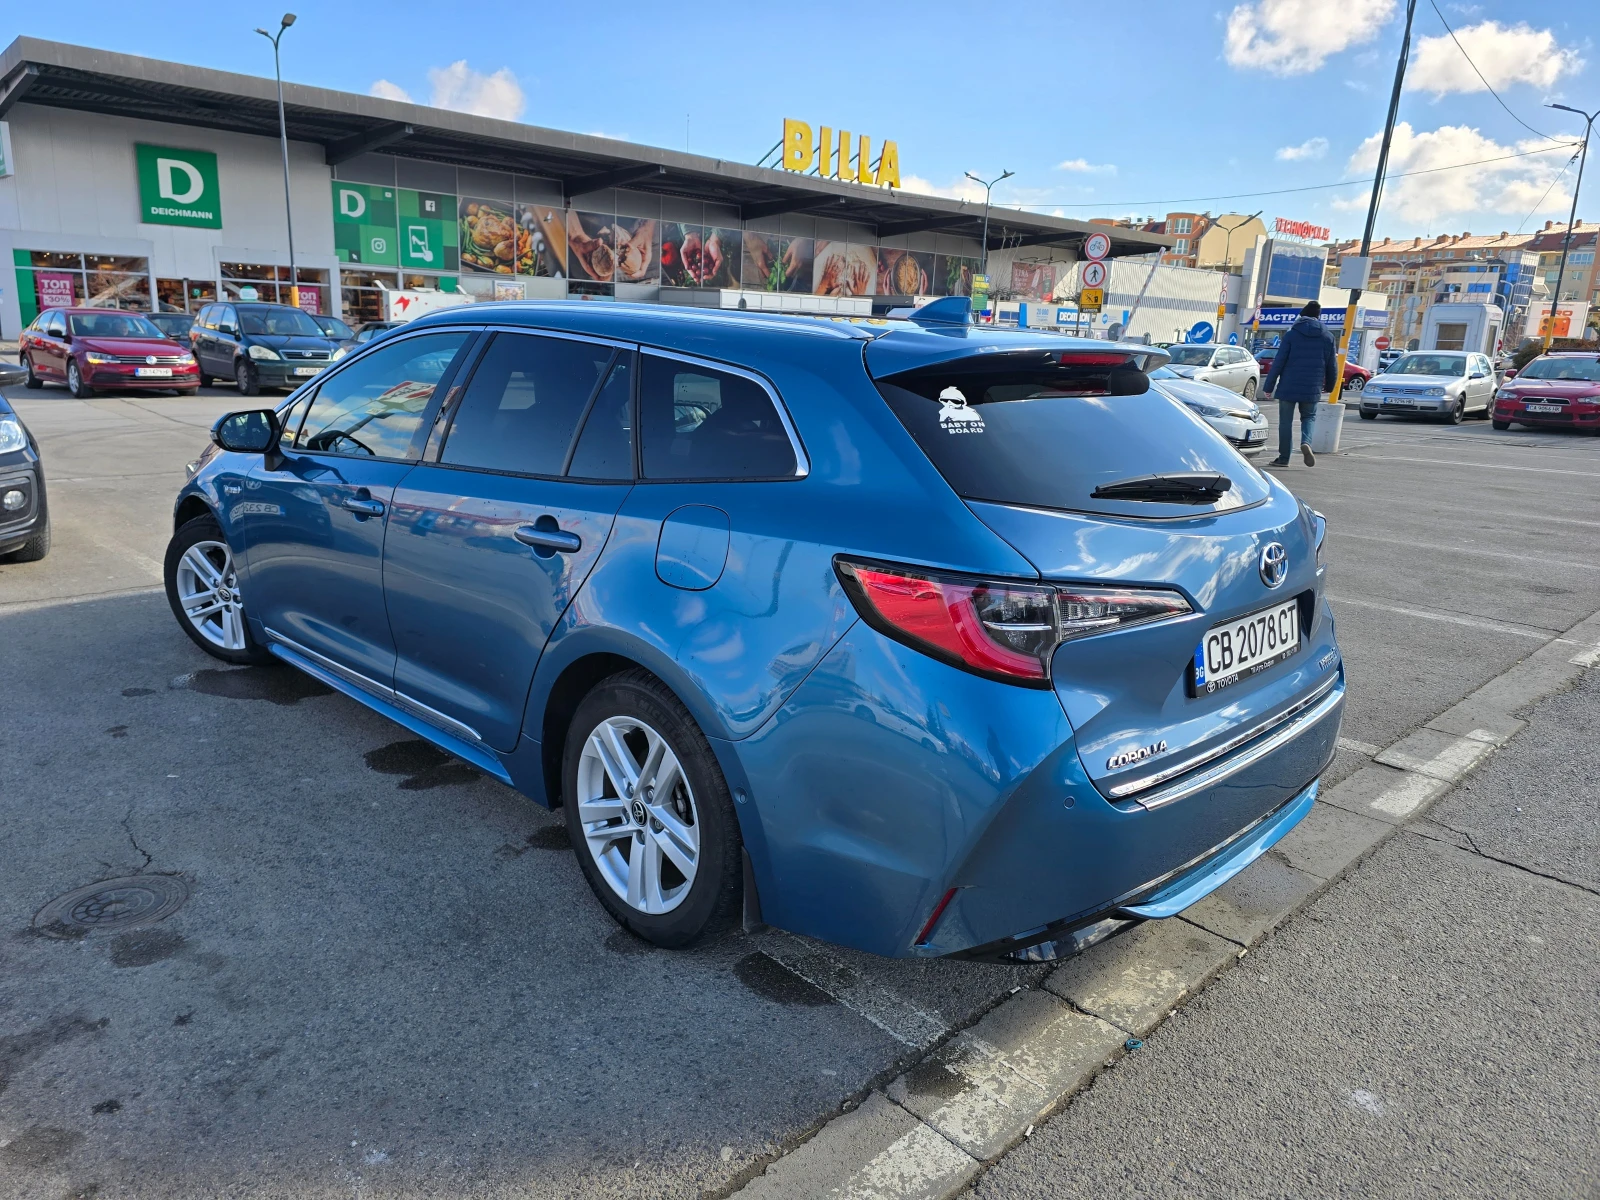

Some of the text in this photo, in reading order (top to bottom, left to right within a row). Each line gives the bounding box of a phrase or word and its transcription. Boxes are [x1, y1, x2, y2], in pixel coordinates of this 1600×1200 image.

[782, 117, 901, 189] BILLA
[156, 157, 205, 205] D
[150, 206, 214, 220] DEICHMANN
[339, 189, 366, 218] D
[1275, 216, 1331, 241] TECHNOPOLIS
[41, 279, 70, 289] ТОП
[940, 421, 967, 429] BABY
[948, 427, 984, 435] BOARD
[1206, 630, 1235, 675] CB
[1235, 613, 1278, 665] 2078
[1278, 604, 1297, 645] CT
[1216, 672, 1240, 690] TOYOTA
[638, 699, 692, 757] MICHELIN
[1105, 739, 1168, 770] COROLLA
